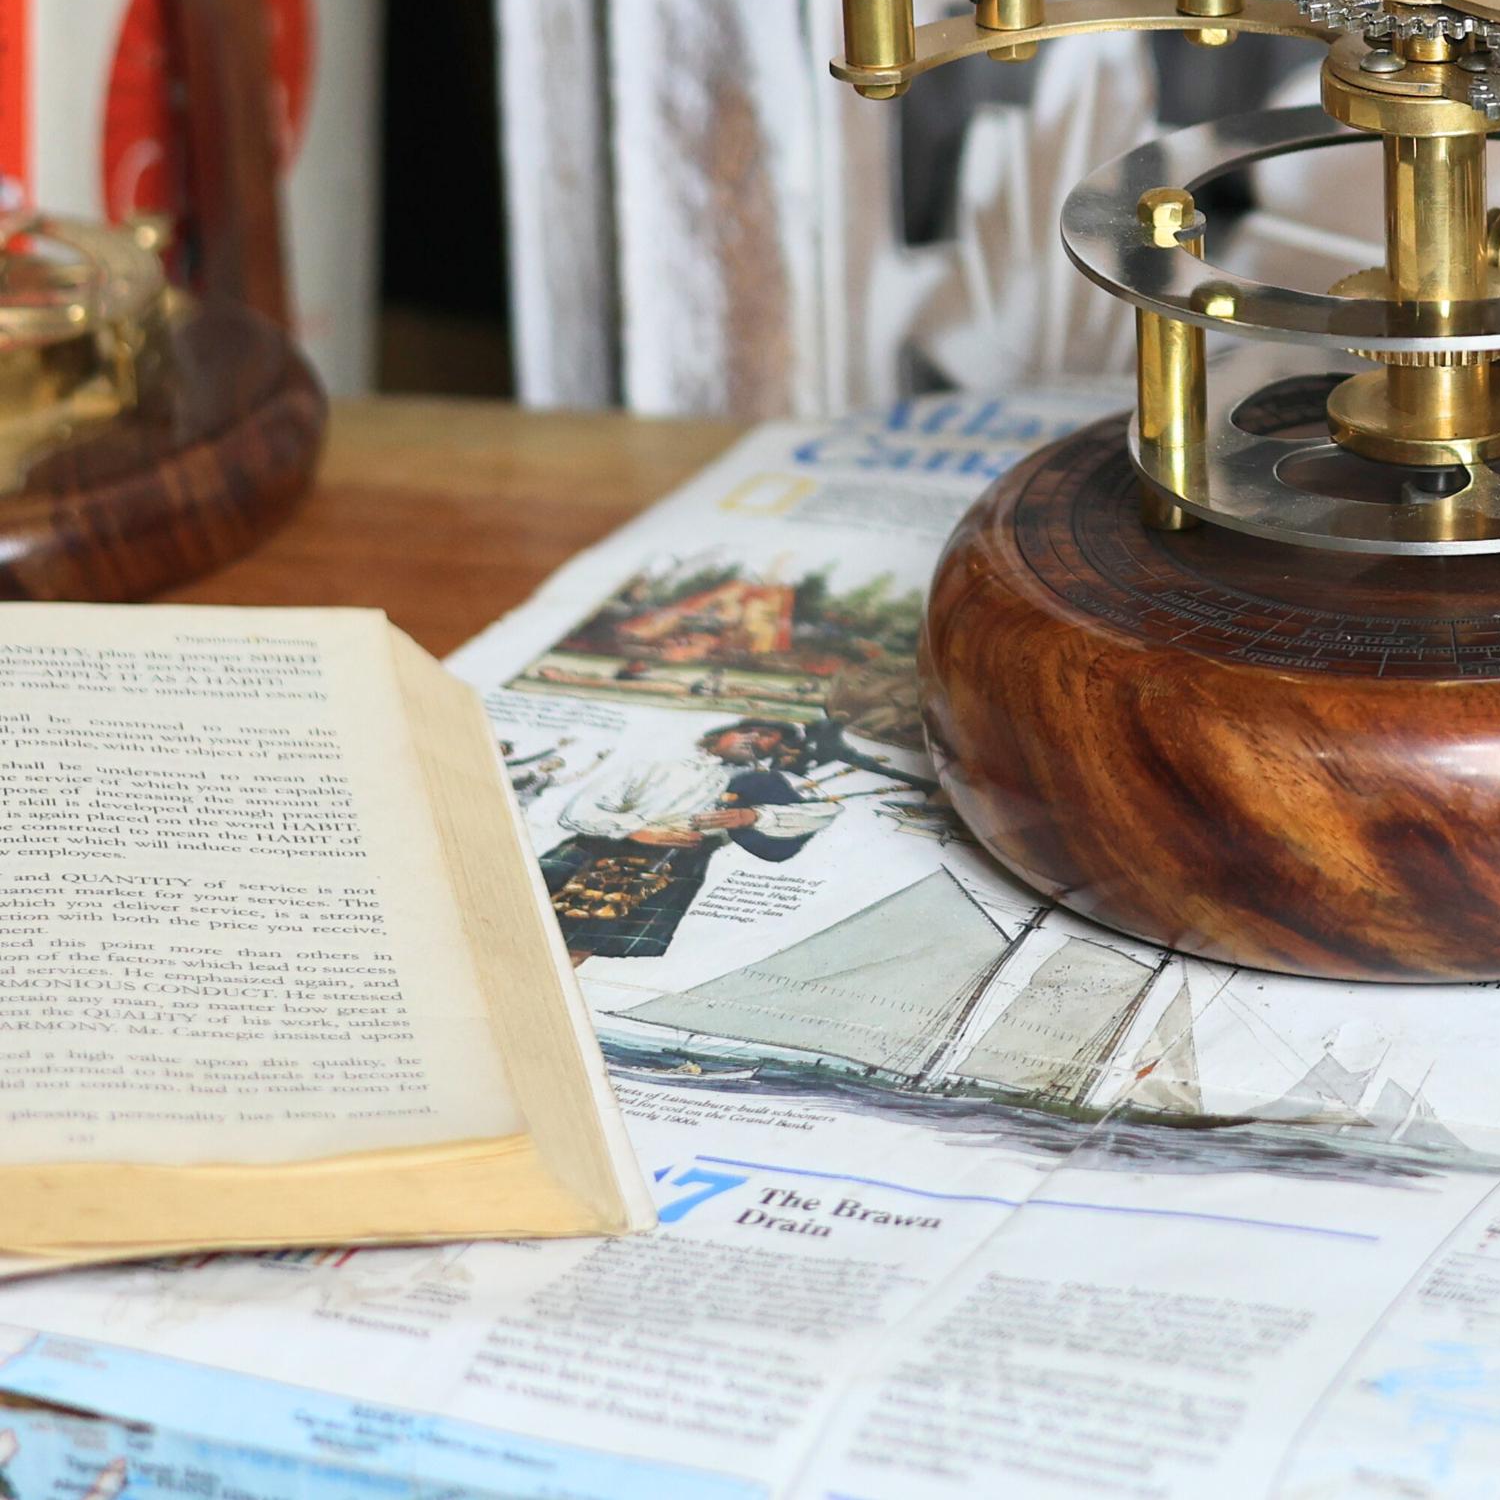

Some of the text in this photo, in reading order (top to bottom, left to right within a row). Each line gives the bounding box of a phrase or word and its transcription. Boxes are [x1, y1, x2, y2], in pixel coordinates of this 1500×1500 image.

[1151, 590, 1427, 651] January February
[1228, 649, 1329, 671] Aquarius
[29, 812, 79, 820] again
[87, 812, 149, 823] placed
[189, 818, 218, 827] the
[225, 822, 275, 830] word
[282, 823, 361, 832] HABIT.
[14, 872, 50, 881] and
[61, 873, 192, 887] QUANTITY
[204, 880, 226, 888] of
[239, 882, 308, 894] service
[318, 885, 333, 894] is
[724, 876, 817, 895] Scottish settlers
[732, 869, 826, 888] Descendants of
[75, 887, 380, 908] market for your services. The
[707, 892, 801, 910] land music and
[714, 885, 802, 901] perform High-
[67, 901, 102, 909] you
[112, 901, 181, 912] deliver
[190, 905, 265, 919] service,
[274, 909, 290, 918] is
[320, 913, 385, 923] strong
[688, 909, 758, 923] gatherings.
[698, 901, 739, 912] dances
[757, 909, 783, 917] clan
[613, 1084, 838, 1122] leets of Lunenburg-built schooners
[625, 1109, 659, 1121] early
[635, 1099, 658, 1112] for
[659, 1104, 684, 1114] cod
[700, 1111, 727, 1121] the
[729, 1114, 775, 1126] Grand
[776, 1120, 815, 1131] Banks
[760, 1187, 821, 1212] The
[830, 1198, 942, 1230] Brawn
[733, 1208, 833, 1238] Drain
